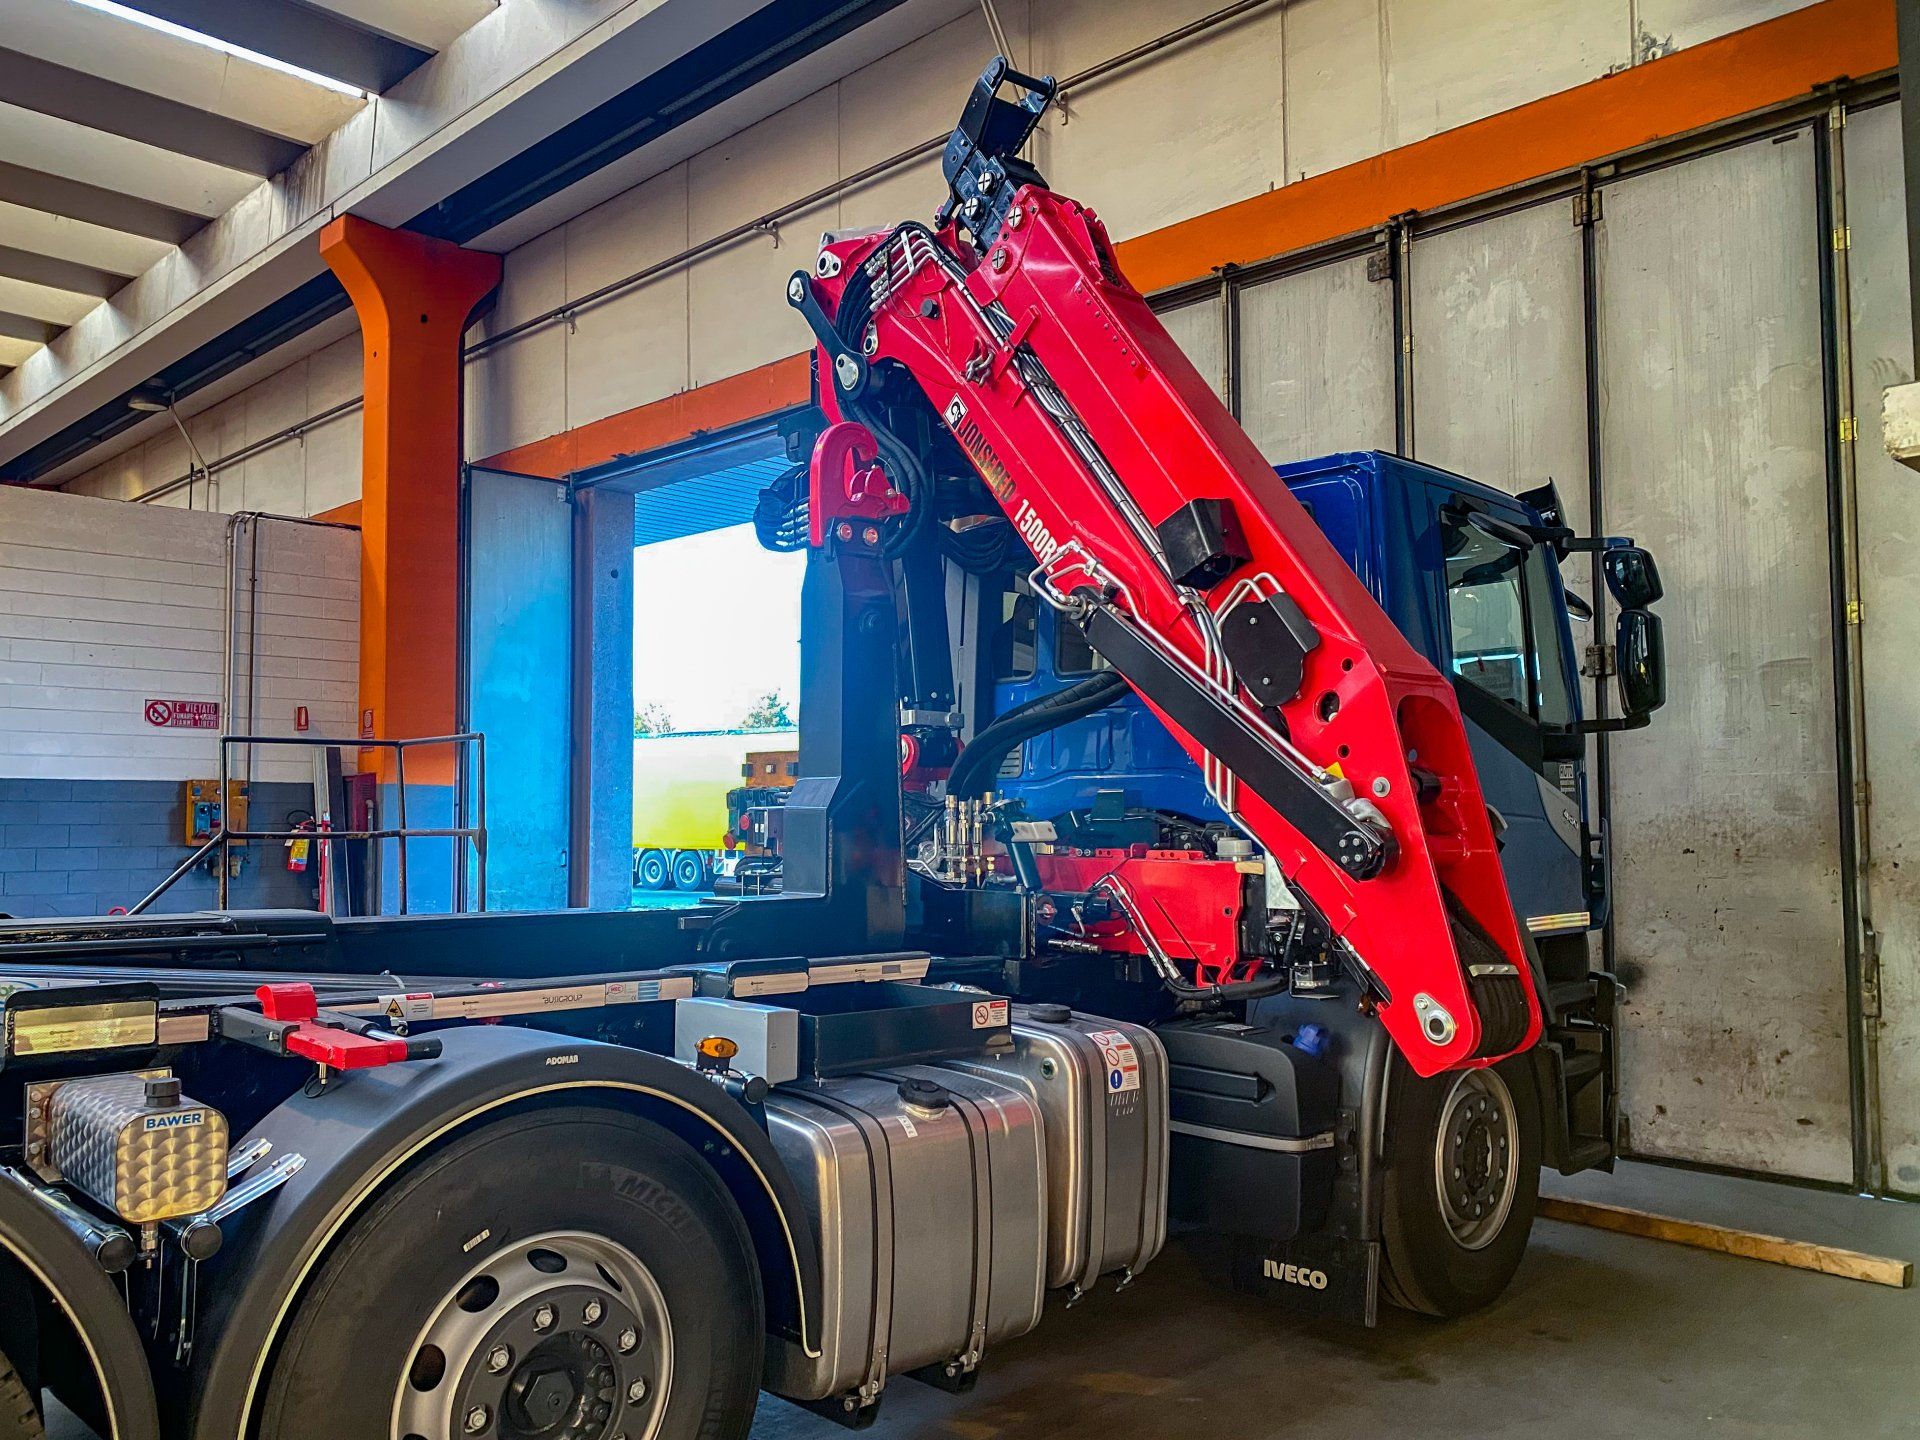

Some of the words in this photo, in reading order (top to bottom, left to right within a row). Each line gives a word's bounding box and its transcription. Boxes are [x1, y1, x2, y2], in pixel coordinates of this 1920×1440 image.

[958, 418, 1017, 504] JONSERED
[185, 703, 216, 714] VIETATO
[146, 1113, 202, 1129] BAWER
[1263, 1259, 1328, 1290] IVECO
